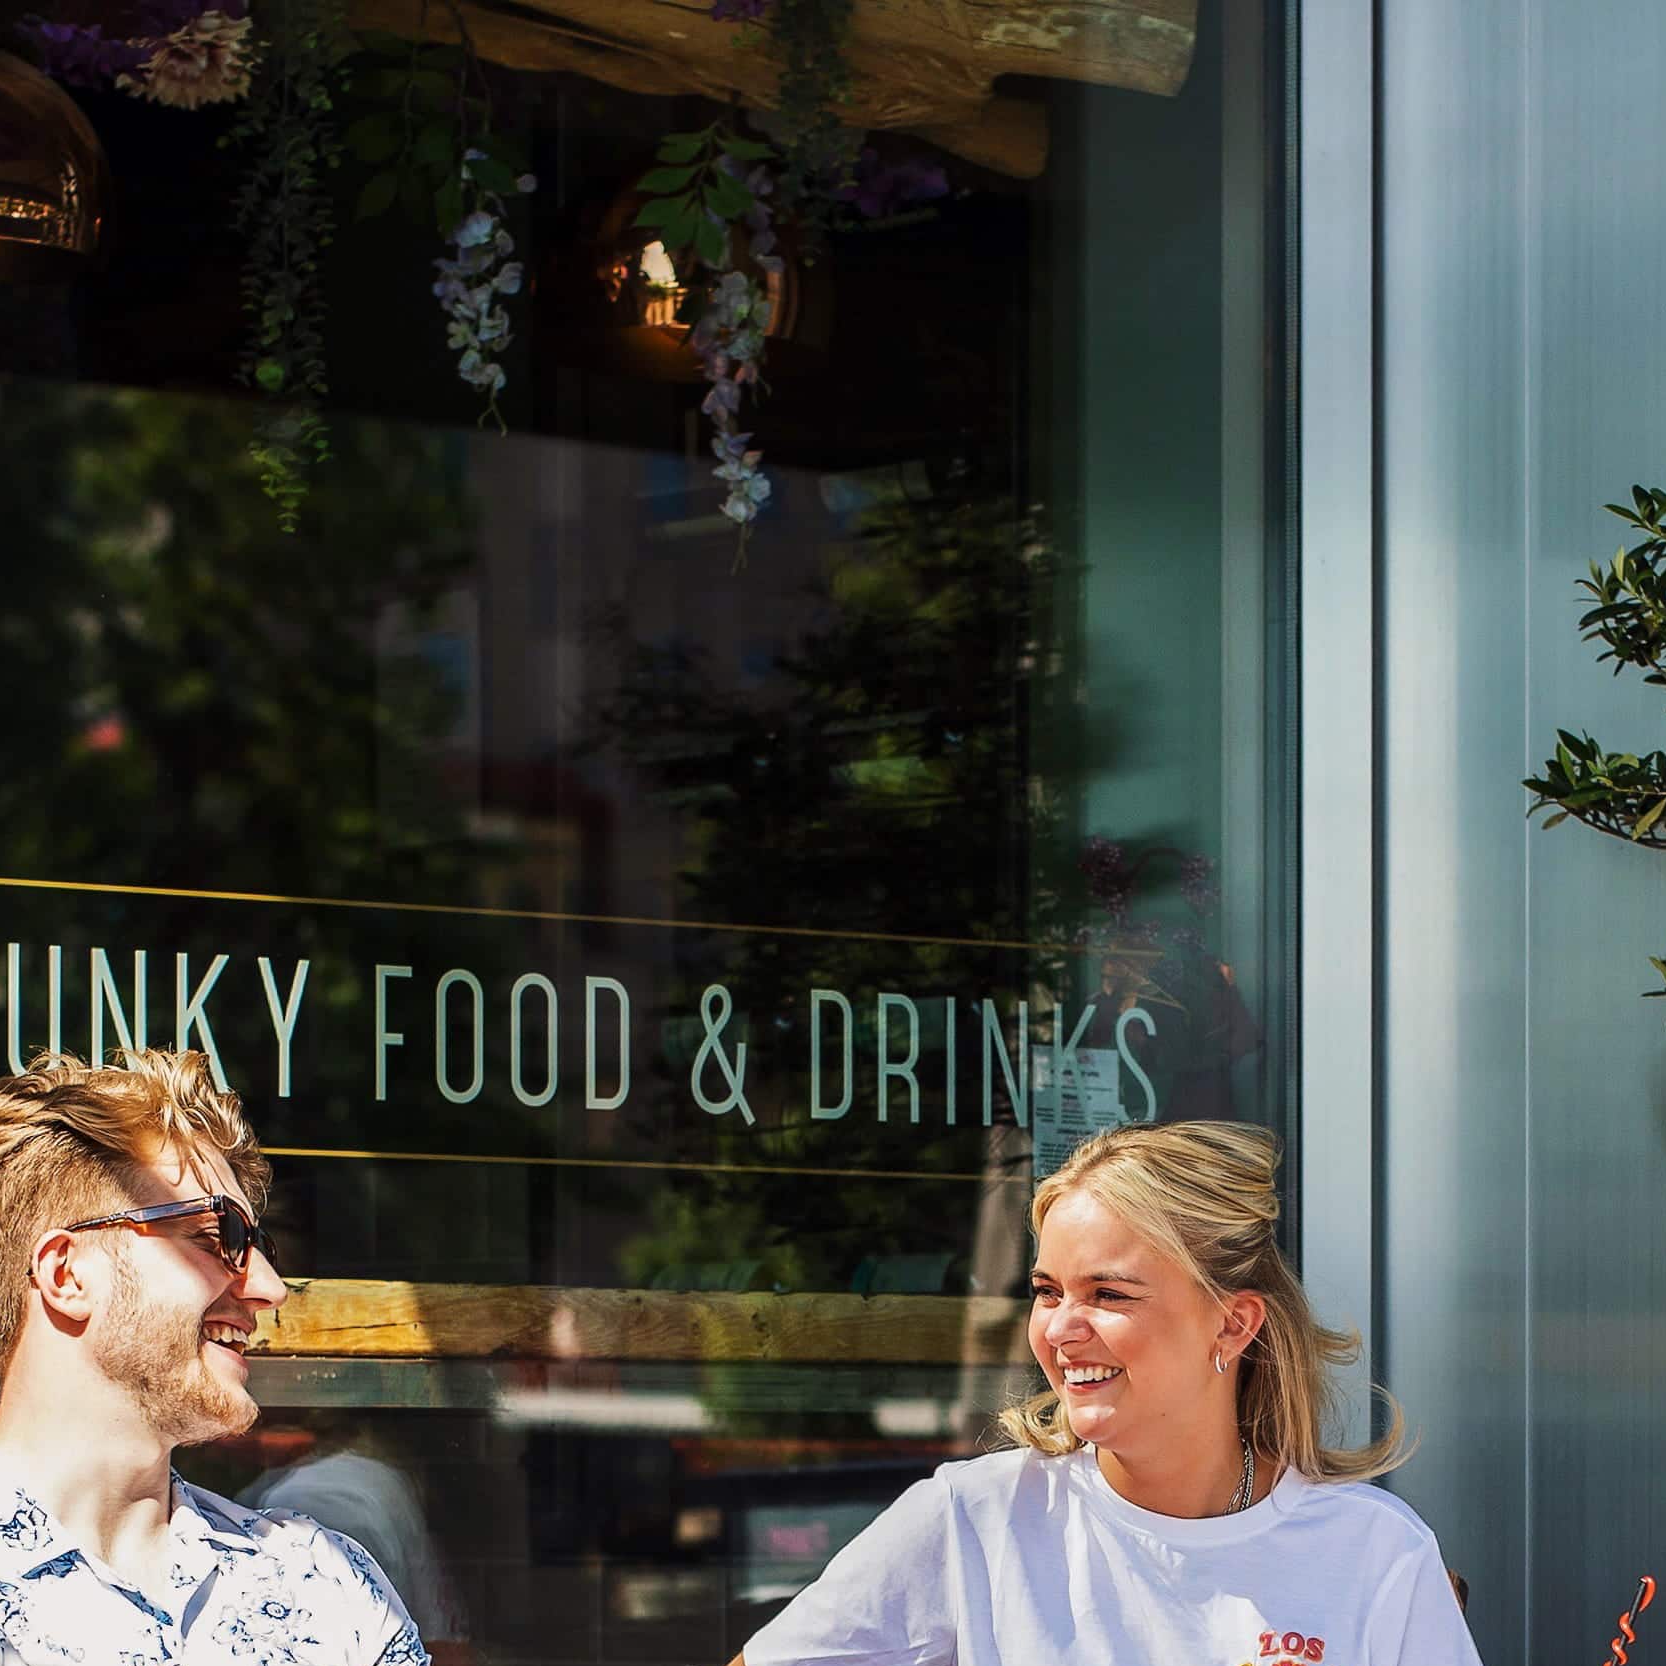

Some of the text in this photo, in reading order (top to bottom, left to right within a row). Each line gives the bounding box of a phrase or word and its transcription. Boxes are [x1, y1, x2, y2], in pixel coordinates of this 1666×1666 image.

[375, 963, 631, 1112] FOOD
[691, 983, 756, 1126] &
[810, 988, 1158, 1129] DRINKS
[1259, 1631, 1325, 1664] LOS
